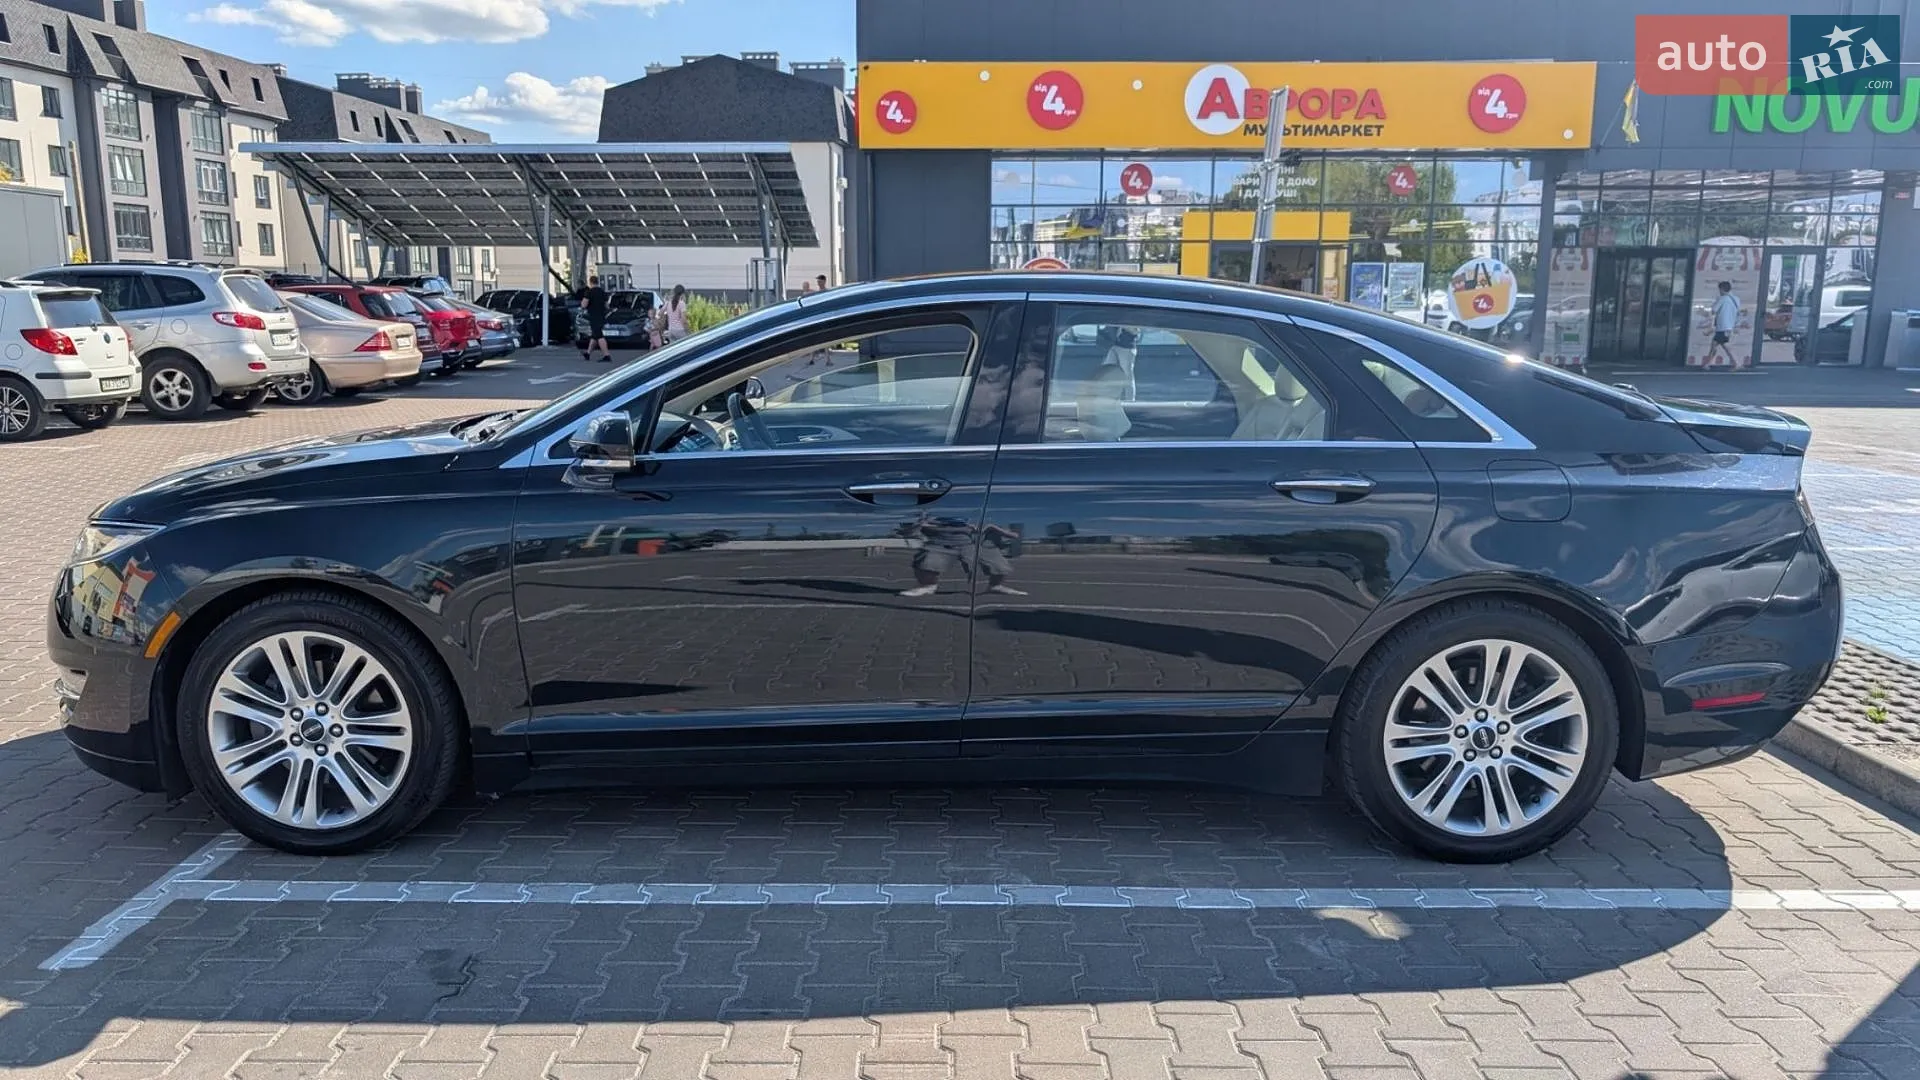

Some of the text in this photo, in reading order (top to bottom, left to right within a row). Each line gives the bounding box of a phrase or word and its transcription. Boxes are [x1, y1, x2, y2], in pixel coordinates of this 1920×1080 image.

[1043, 85, 1065, 115] 4
[1485, 88, 1508, 118] 4
[886, 100, 903, 123] 4
[1243, 124, 1384, 136] МУЬТИМАРКЕТ
[1128, 171, 1143, 189] 4
[1395, 172, 1408, 188] 4
